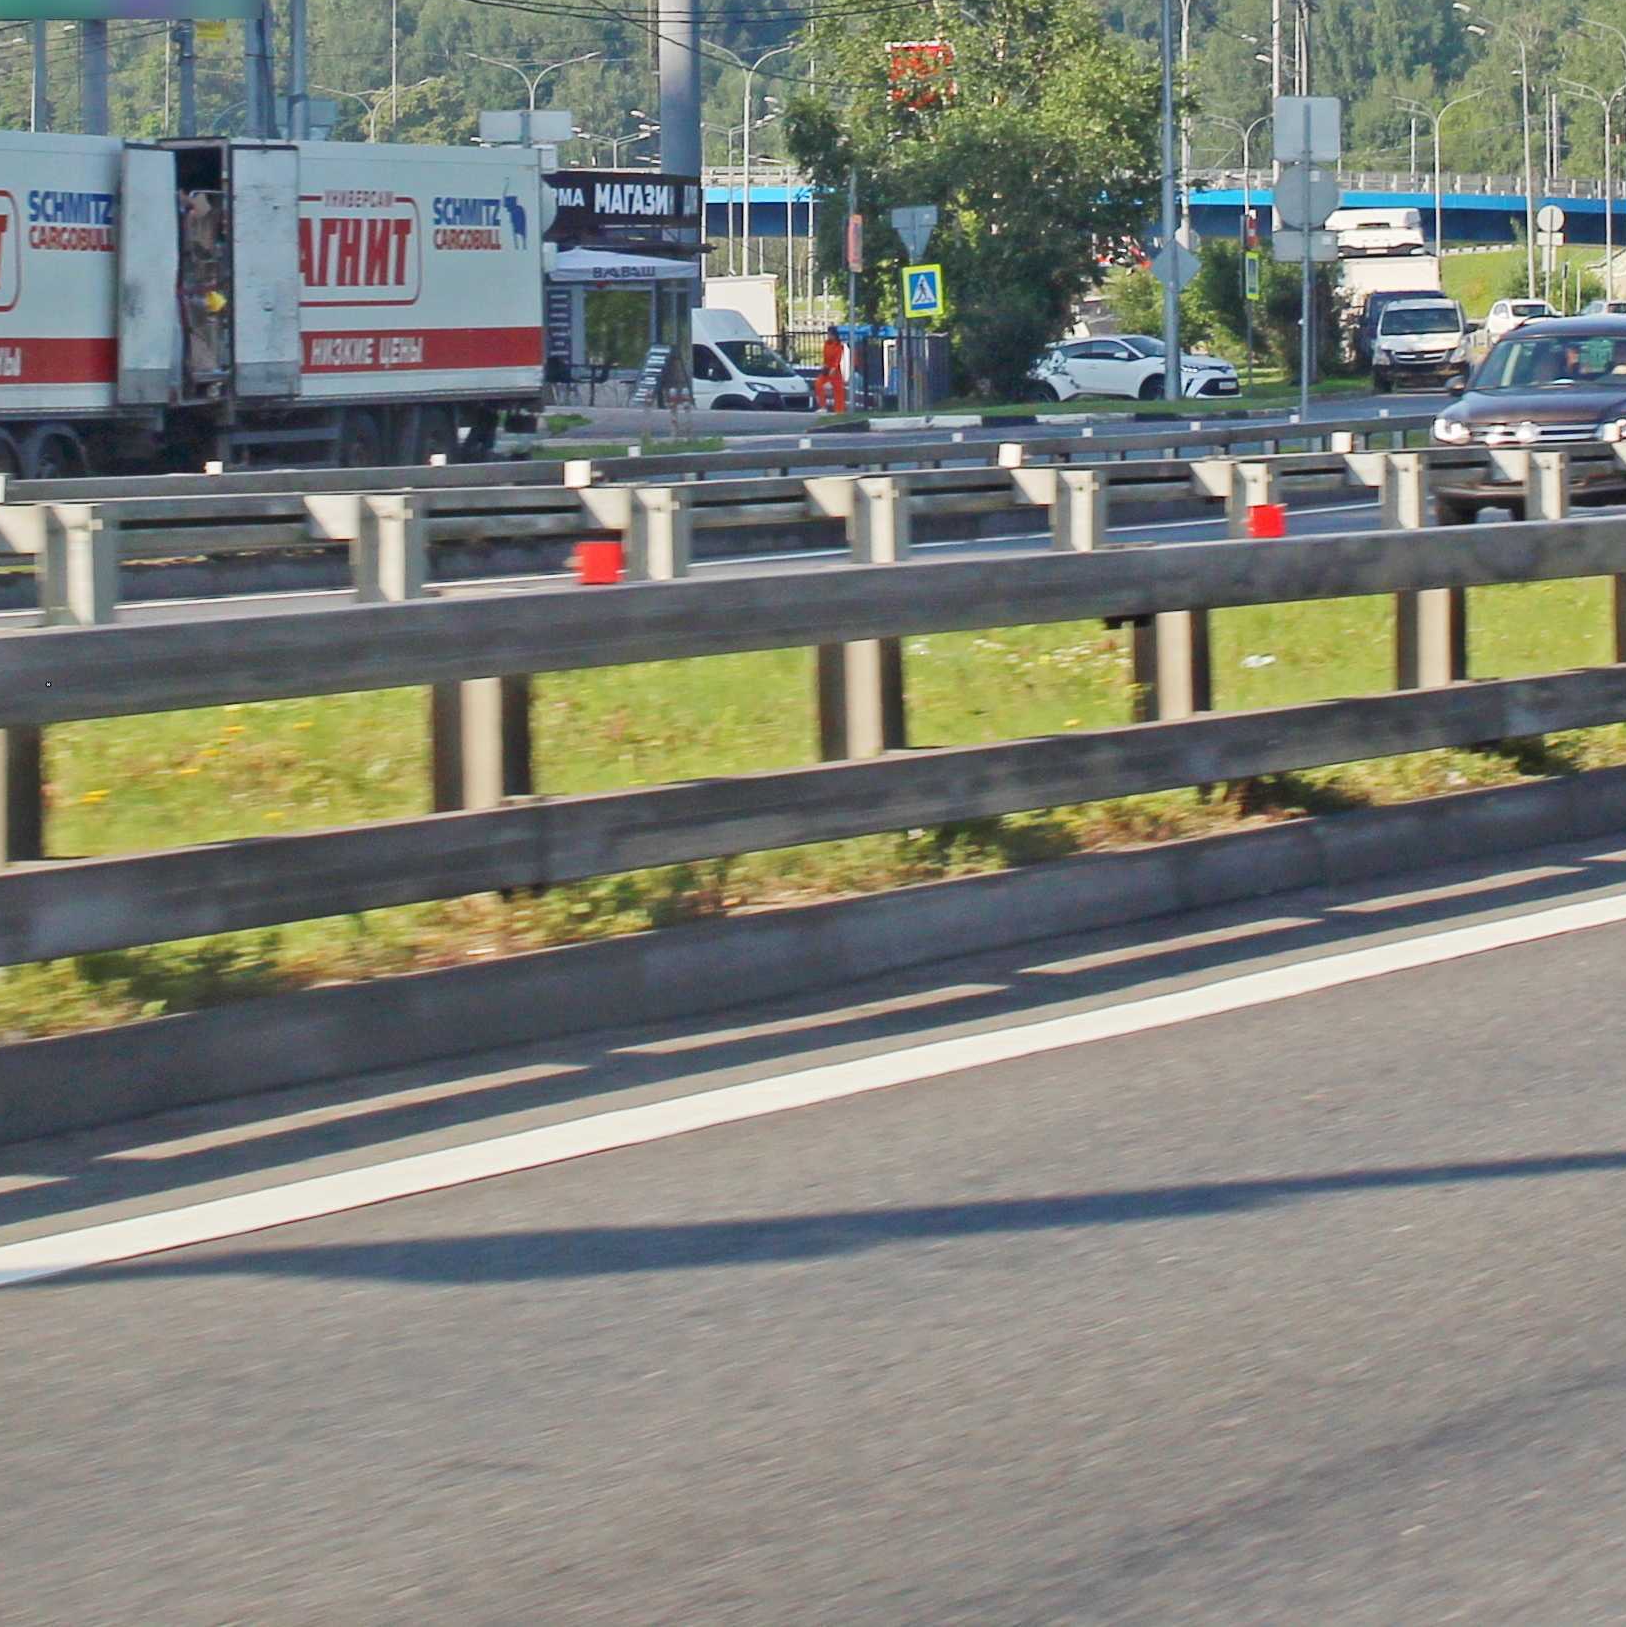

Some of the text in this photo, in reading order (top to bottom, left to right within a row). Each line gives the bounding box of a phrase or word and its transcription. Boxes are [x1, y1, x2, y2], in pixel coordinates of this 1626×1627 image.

[28, 189, 115, 225] SCHMITZ
[432, 196, 502, 227] SCHMITZ
[28, 225, 117, 252] CARGOBULL
[299, 217, 412, 287] АГНИТ
[311, 337, 424, 369] НИЗКИЕ ЦЕНЫ
